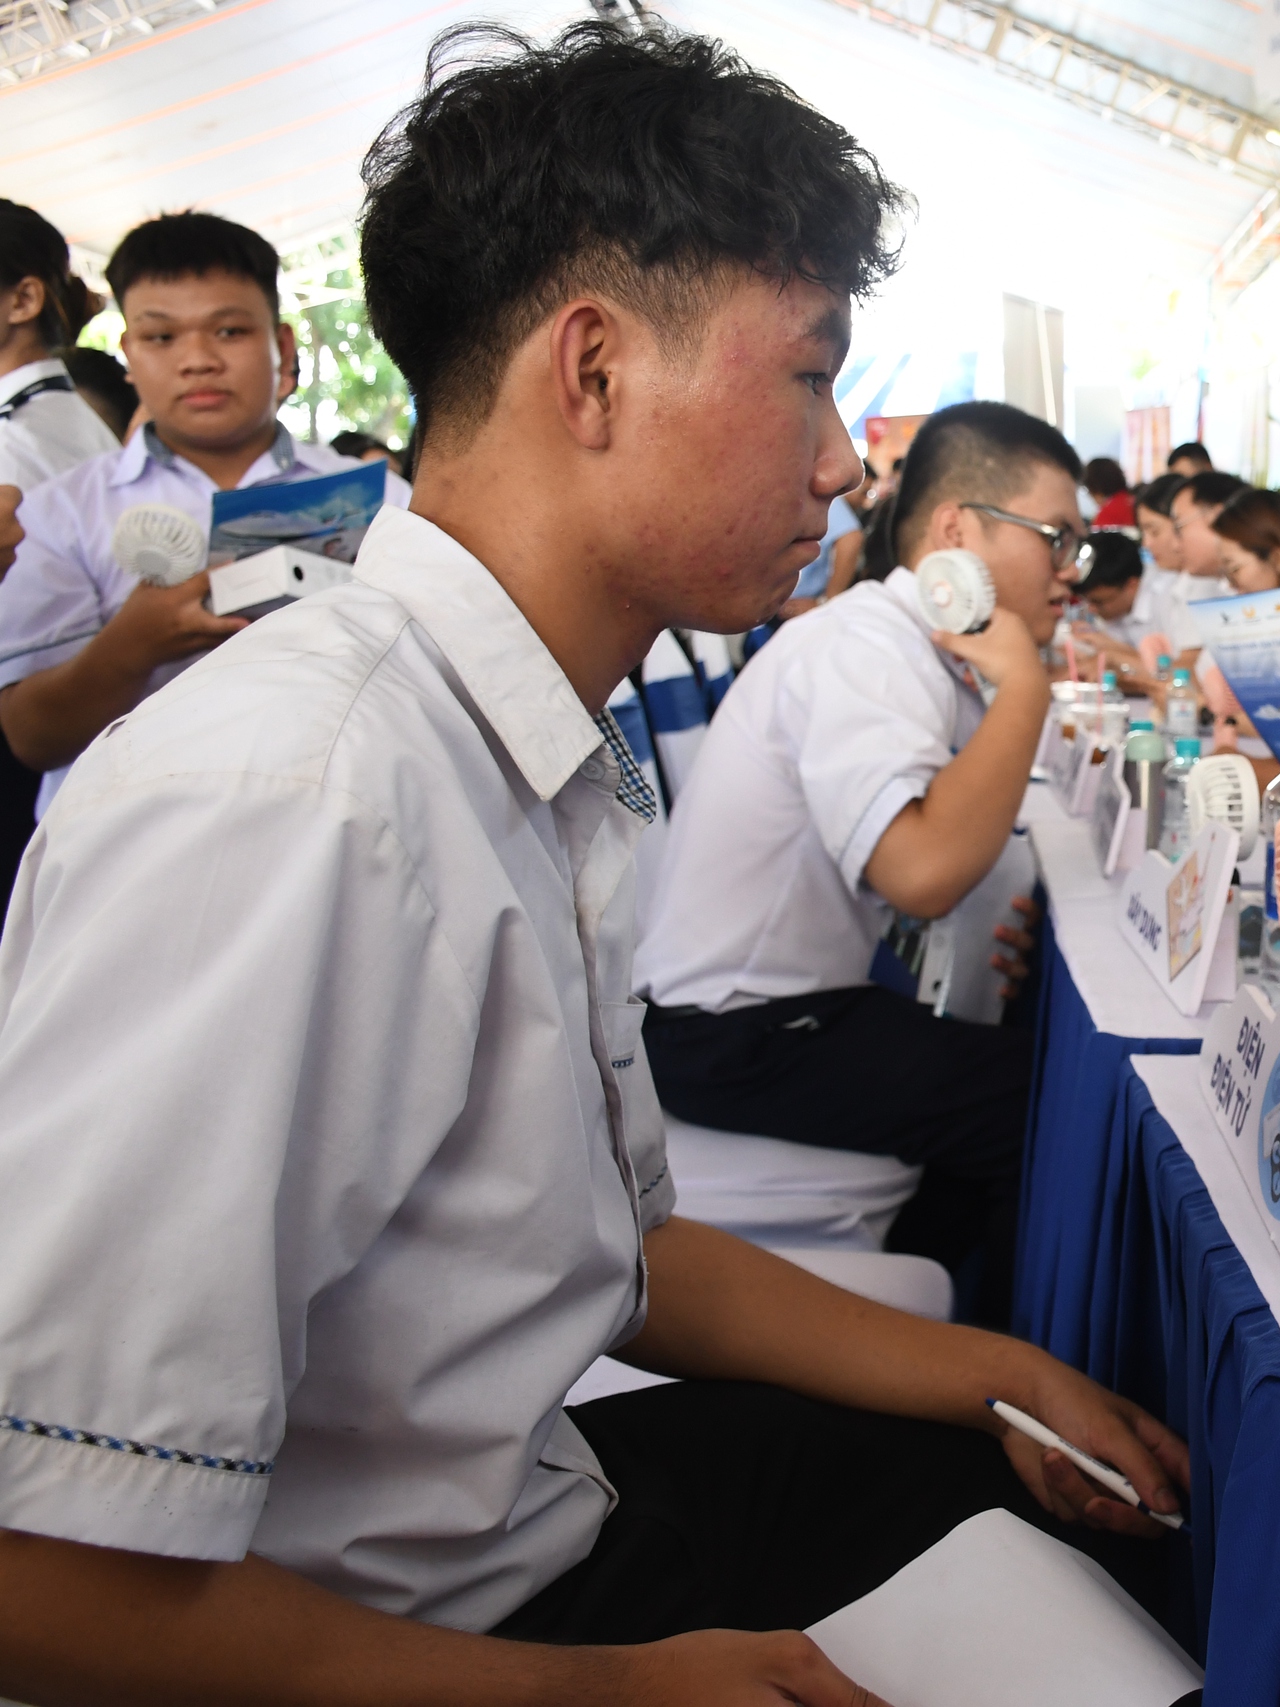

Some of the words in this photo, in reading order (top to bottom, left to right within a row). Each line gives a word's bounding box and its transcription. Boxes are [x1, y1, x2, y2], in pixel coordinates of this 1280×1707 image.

[1237, 1016, 1266, 1081] ĐIỆN
[1210, 1052, 1236, 1115] ĐIỆN
[1230, 1085, 1252, 1138] TỬ
